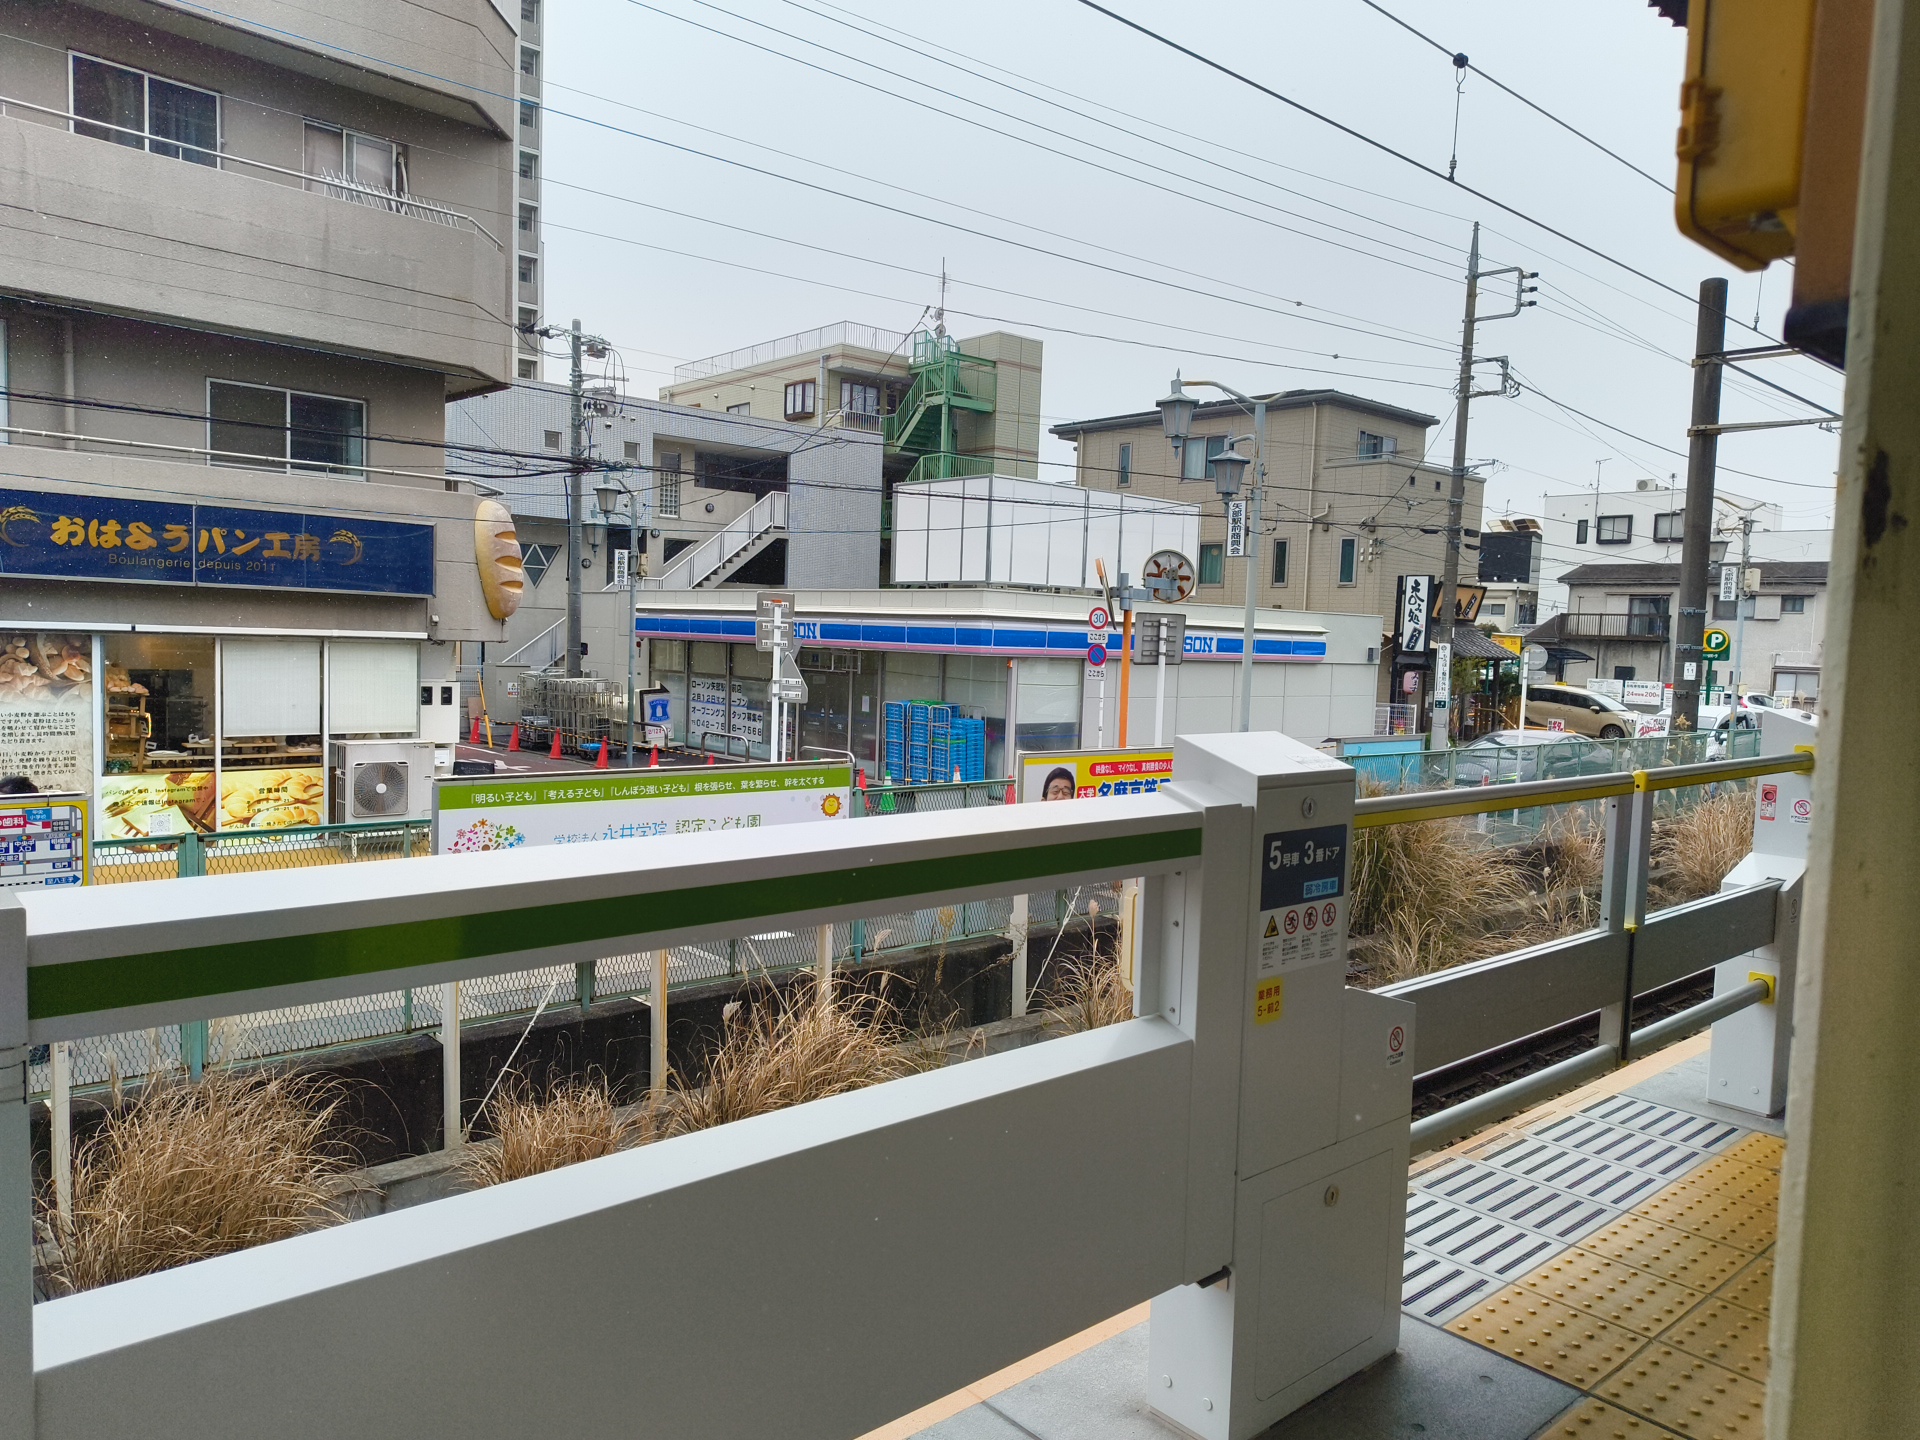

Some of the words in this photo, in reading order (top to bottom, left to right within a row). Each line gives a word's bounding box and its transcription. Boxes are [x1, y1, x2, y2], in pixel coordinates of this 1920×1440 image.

[50, 516, 321, 562] おはようパン工房
[109, 553, 191, 569] Boulangerie
[198, 558, 241, 573] depuis
[246, 562, 276, 573] 2011
[1093, 613, 1105, 624] 30
[1089, 632, 1106, 641] ここから
[1711, 634, 1723, 648] P
[1183, 636, 1214, 654] SON
[1088, 669, 1105, 678] ここから
[1411, 672, 1419, 692] みます
[259, 786, 288, 794] 営業時間
[1078, 787, 1095, 799] 大学
[675, 814, 761, 835] 認定こども園
[553, 833, 599, 845] 学校法人
[1269, 840, 1300, 870] 5号車
[1303, 840, 1340, 865] 3番ドア
[1258, 985, 1280, 1001] 業務用
